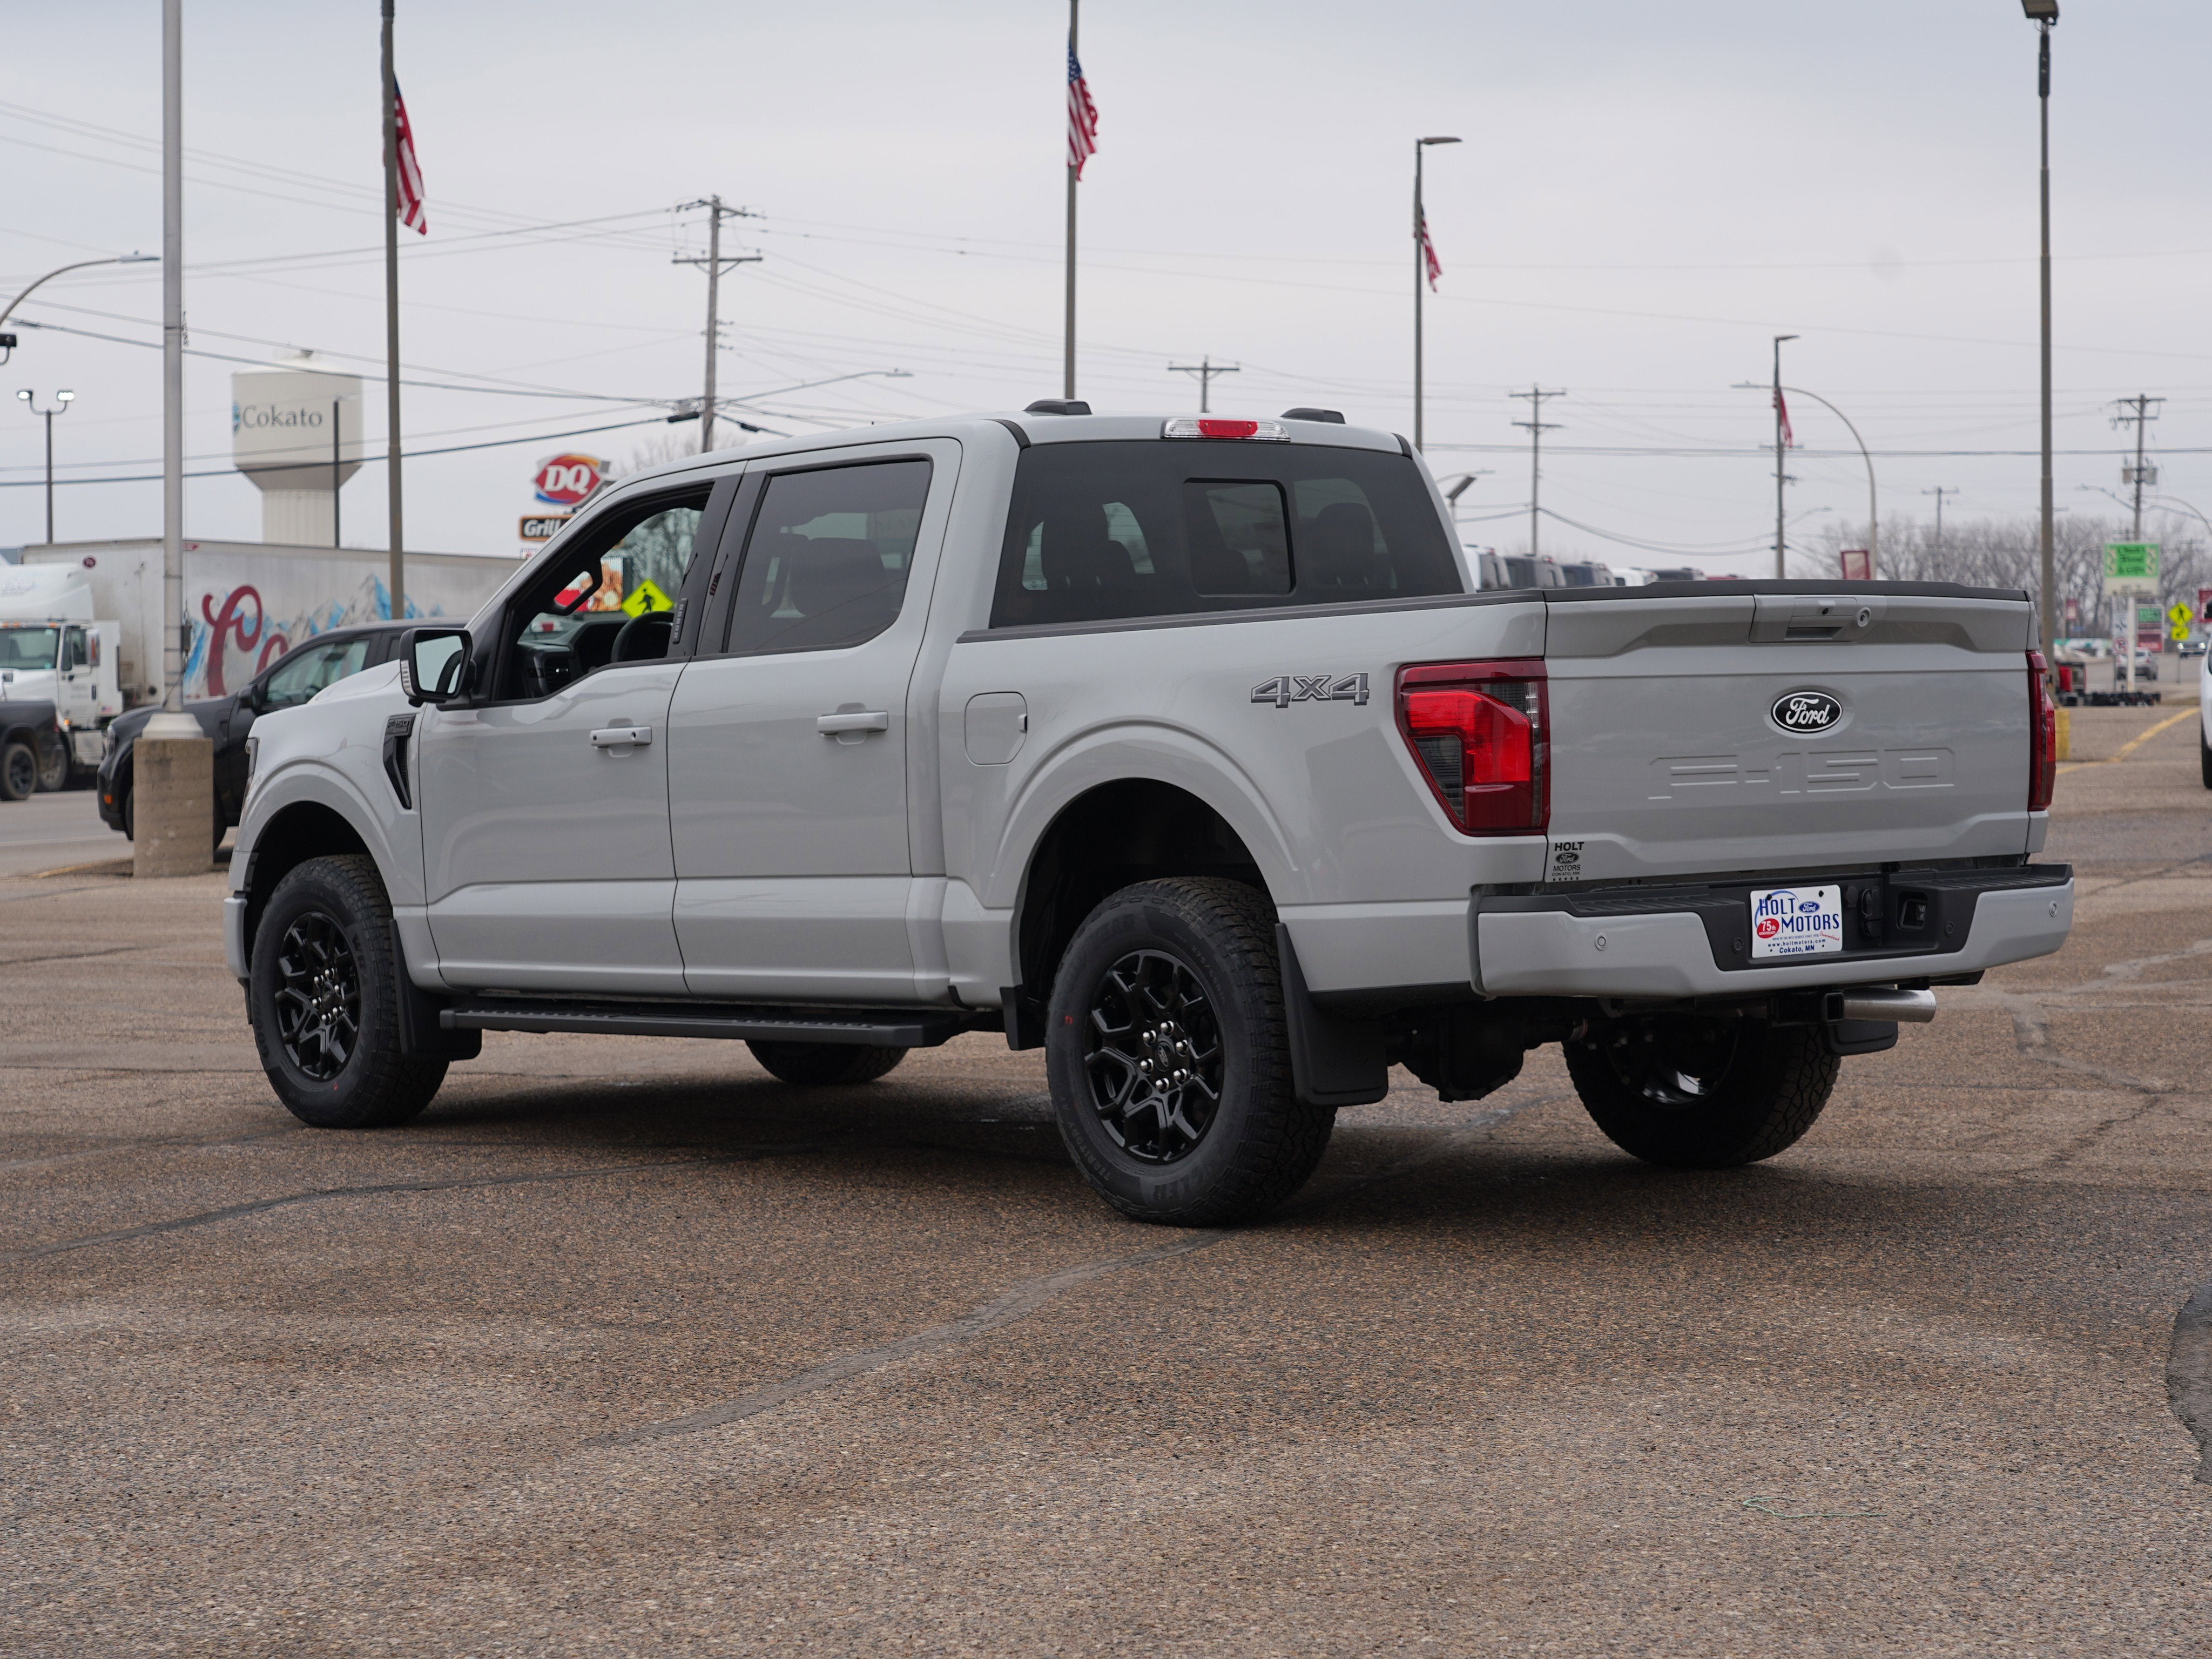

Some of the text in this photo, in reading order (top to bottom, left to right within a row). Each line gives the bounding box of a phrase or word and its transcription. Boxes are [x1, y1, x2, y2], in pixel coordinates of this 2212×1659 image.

[243, 404, 323, 429] Cokato
[543, 463, 591, 495] DQ
[1785, 697, 1831, 725] Ford
[1648, 747, 1955, 799] F-150
[1554, 841, 1584, 851] HOLT
[1759, 898, 1796, 916] HOLT
[1761, 920, 1777, 932] 75th
[1782, 913, 1839, 933] MOTORS
[1768, 939, 1826, 947] www.holtmotors.com
